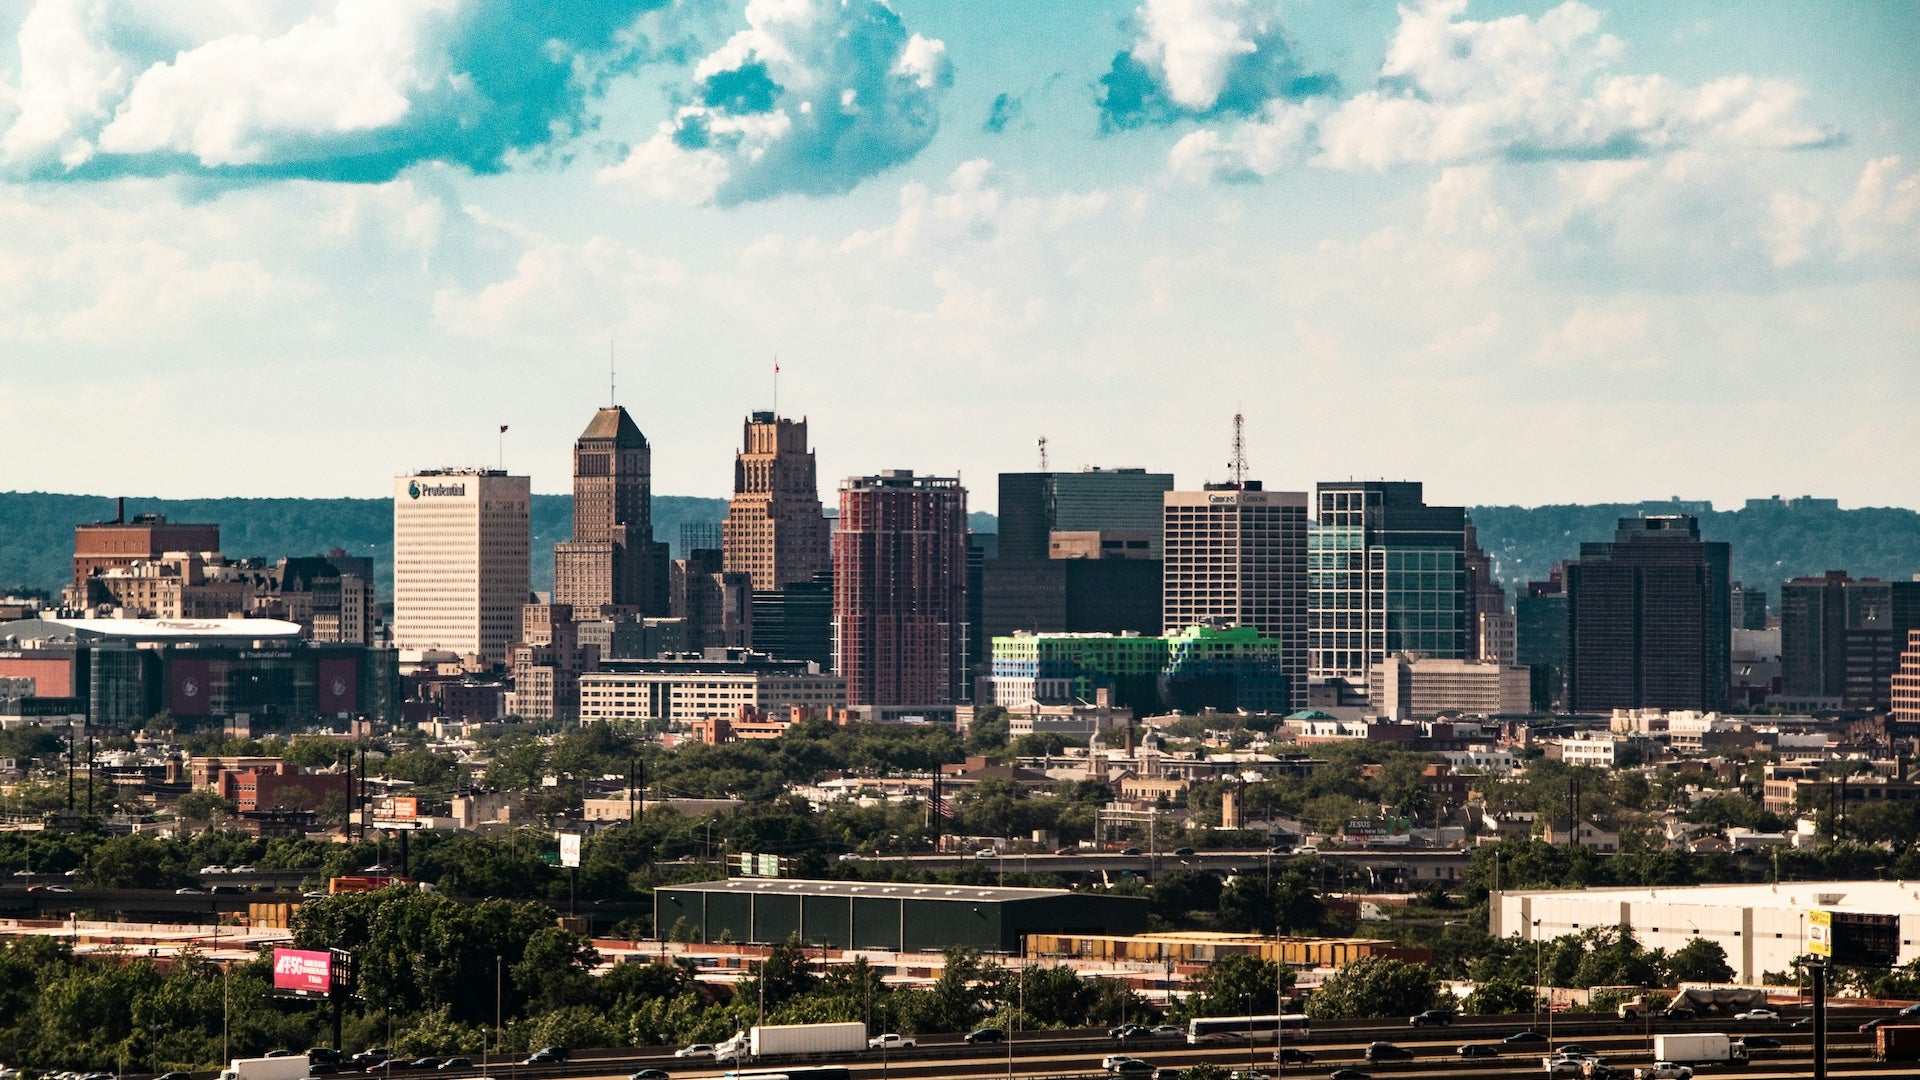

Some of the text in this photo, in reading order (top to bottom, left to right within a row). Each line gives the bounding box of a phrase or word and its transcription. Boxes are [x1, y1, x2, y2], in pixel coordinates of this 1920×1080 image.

[422, 482, 465, 497] Prudential
[247, 651, 292, 659] Prudential Center
